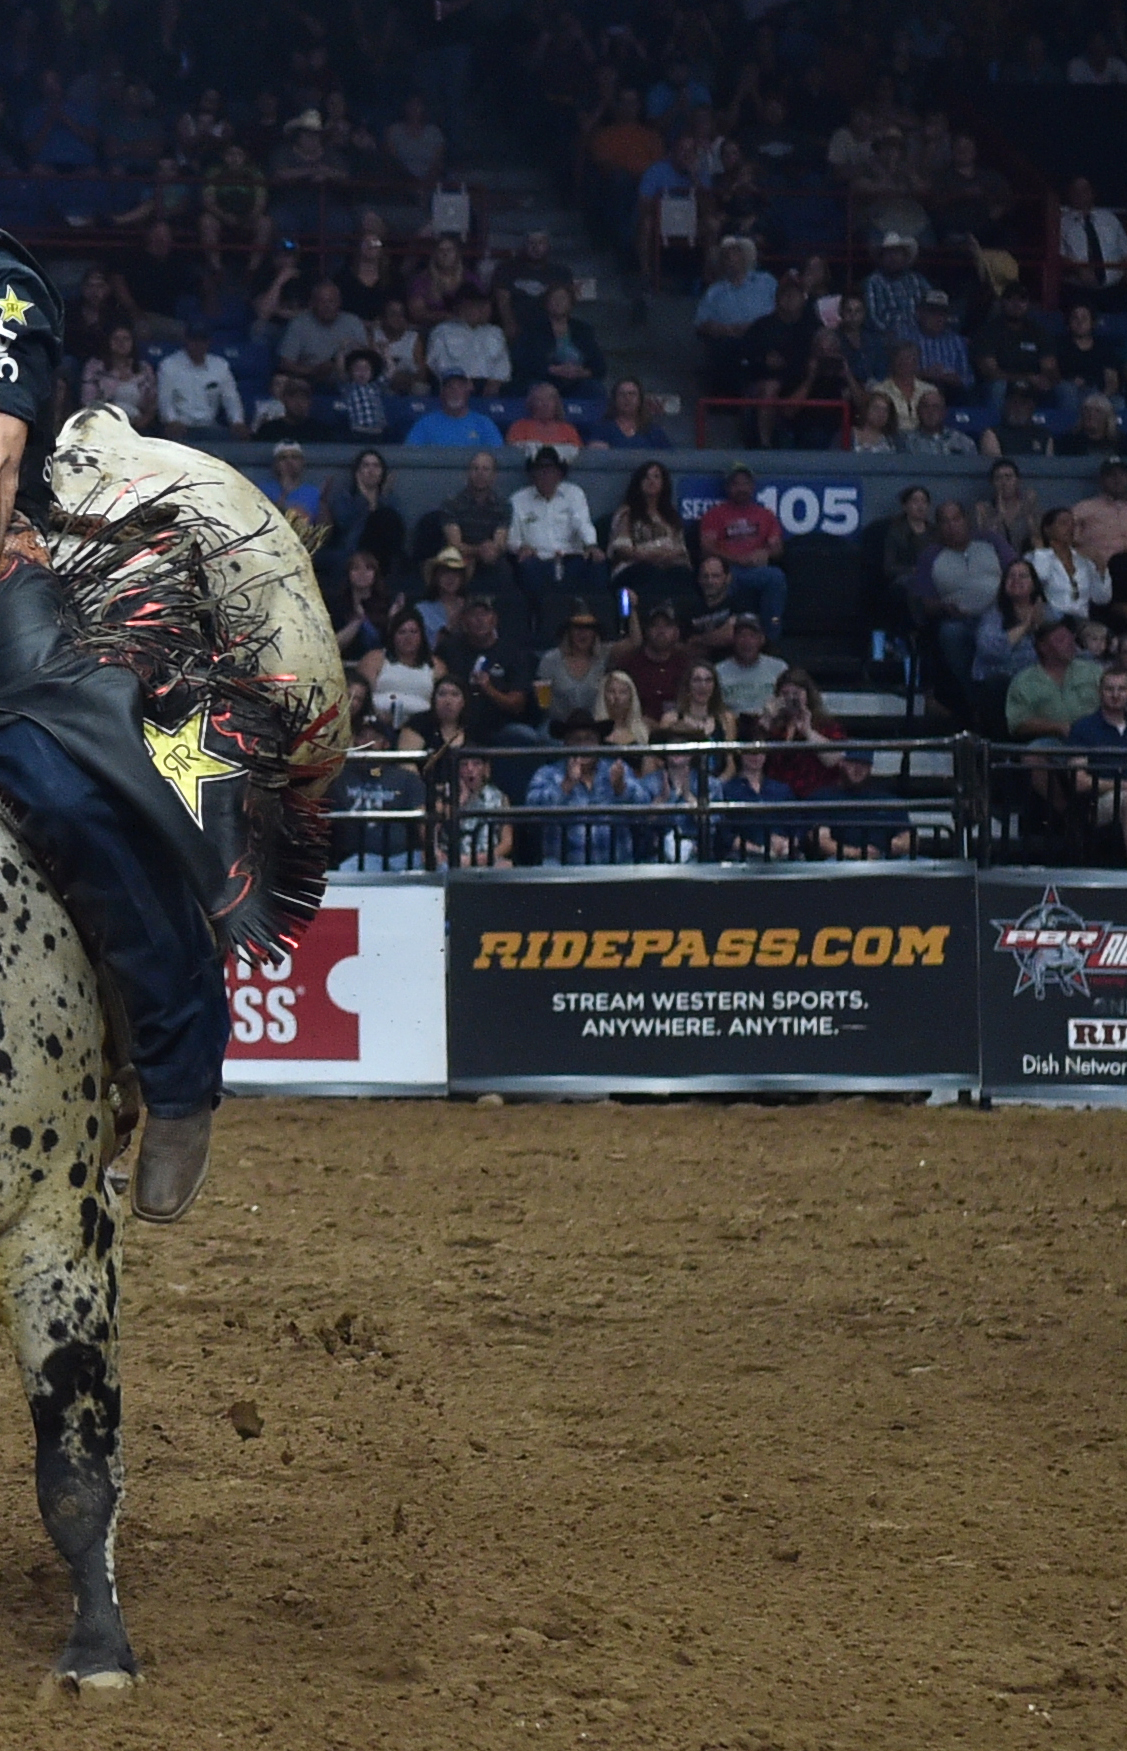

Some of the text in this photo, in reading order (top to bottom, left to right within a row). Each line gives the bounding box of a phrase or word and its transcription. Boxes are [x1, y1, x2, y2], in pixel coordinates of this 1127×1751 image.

[756, 486, 859, 536] 105
[473, 925, 950, 969] RIDEPASS.COM
[552, 990, 870, 1012] STREAM WESTERN SPORTS.
[582, 1015, 840, 1037] ANYWHERE. ANYTIME.
[1023, 1052, 1060, 1075] Dish
